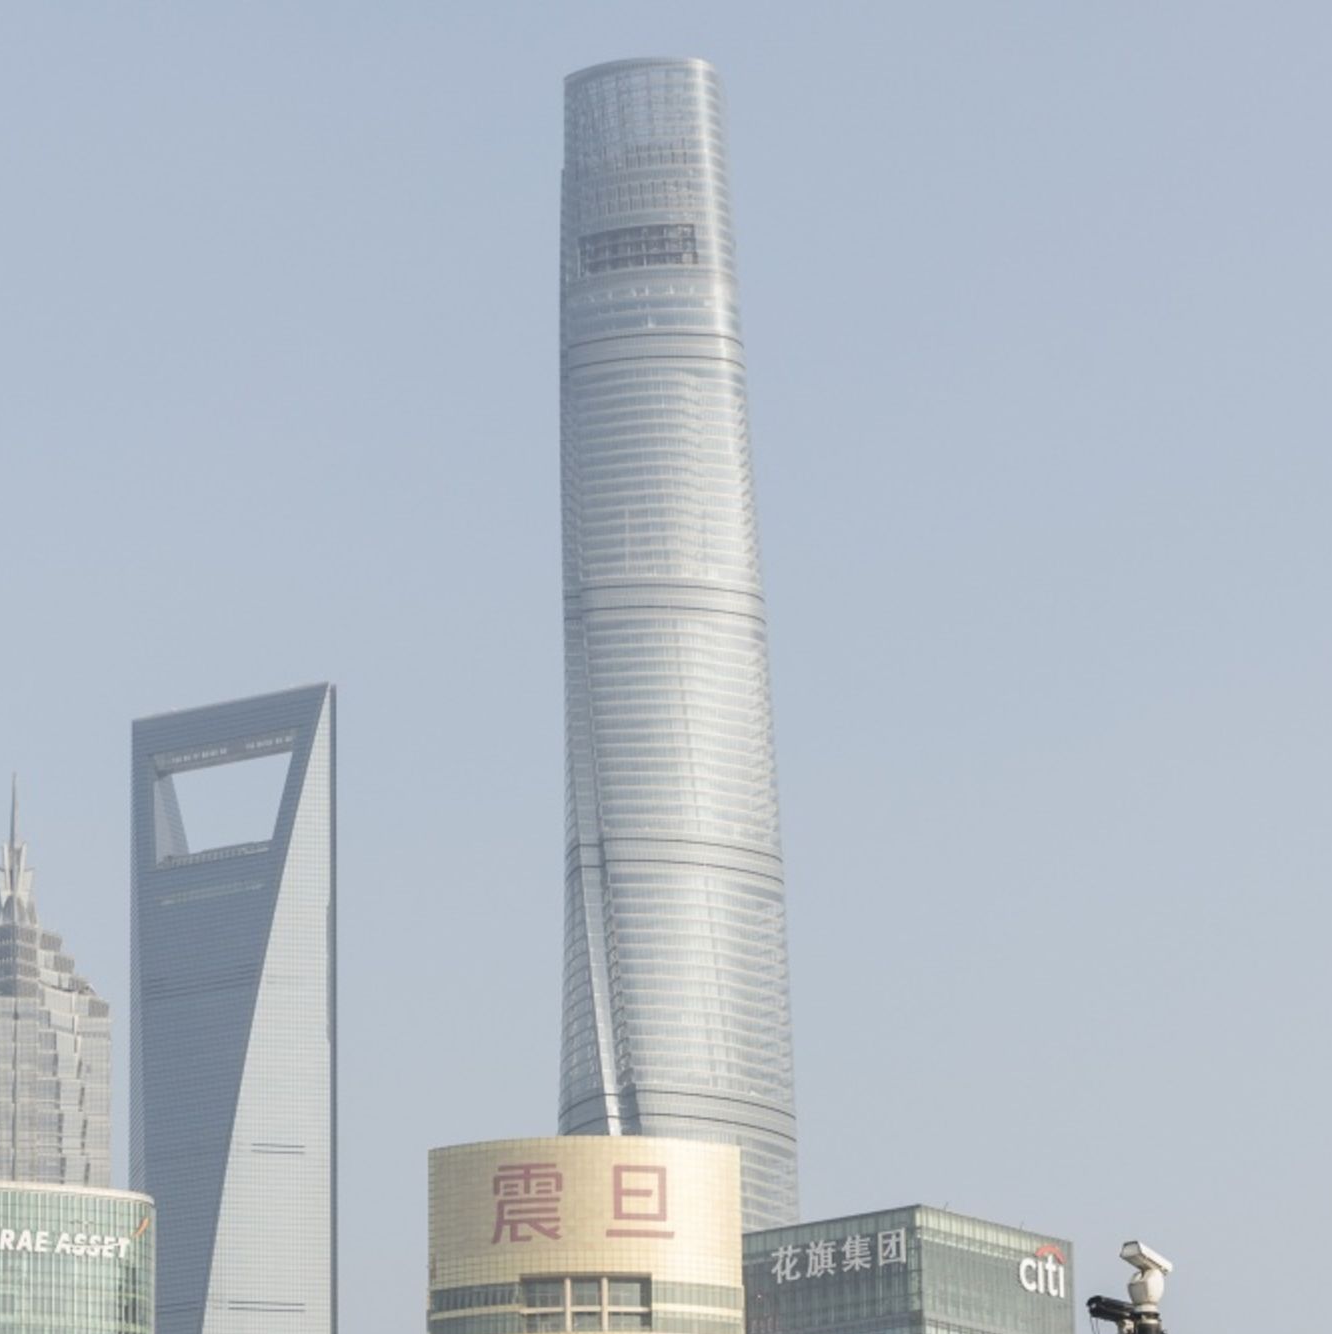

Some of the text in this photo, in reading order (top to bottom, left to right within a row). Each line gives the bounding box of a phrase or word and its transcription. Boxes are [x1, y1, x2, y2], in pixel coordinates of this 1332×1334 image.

[491, 1163, 675, 1244] 震旦
[55, 1232, 131, 1259] ASSET
[771, 1228, 907, 1284] 花旗集团
[1019, 1245, 1066, 1299] citi
